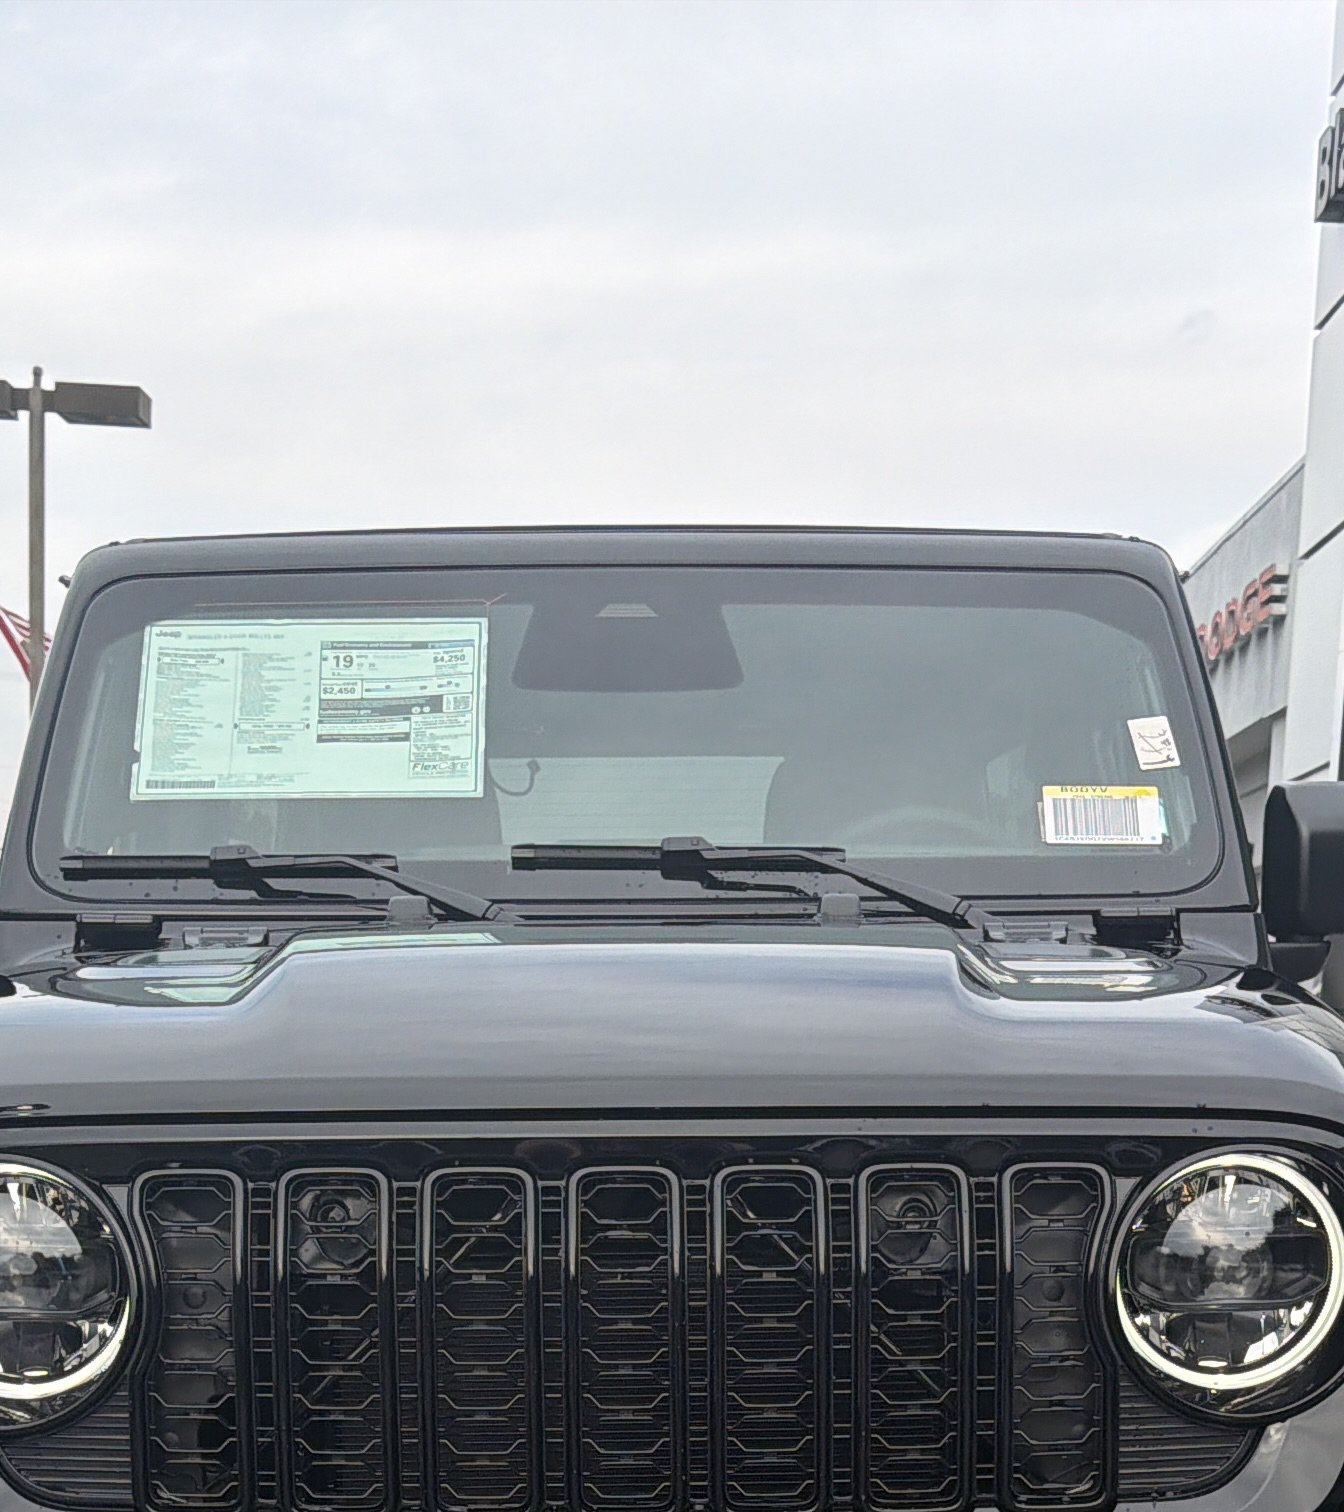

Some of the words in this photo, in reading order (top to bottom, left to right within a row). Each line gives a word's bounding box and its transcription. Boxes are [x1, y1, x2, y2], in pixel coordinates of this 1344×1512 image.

[332, 654, 354, 668] 19
[433, 654, 466, 663] $4,250
[322, 687, 356, 696] $2,450
